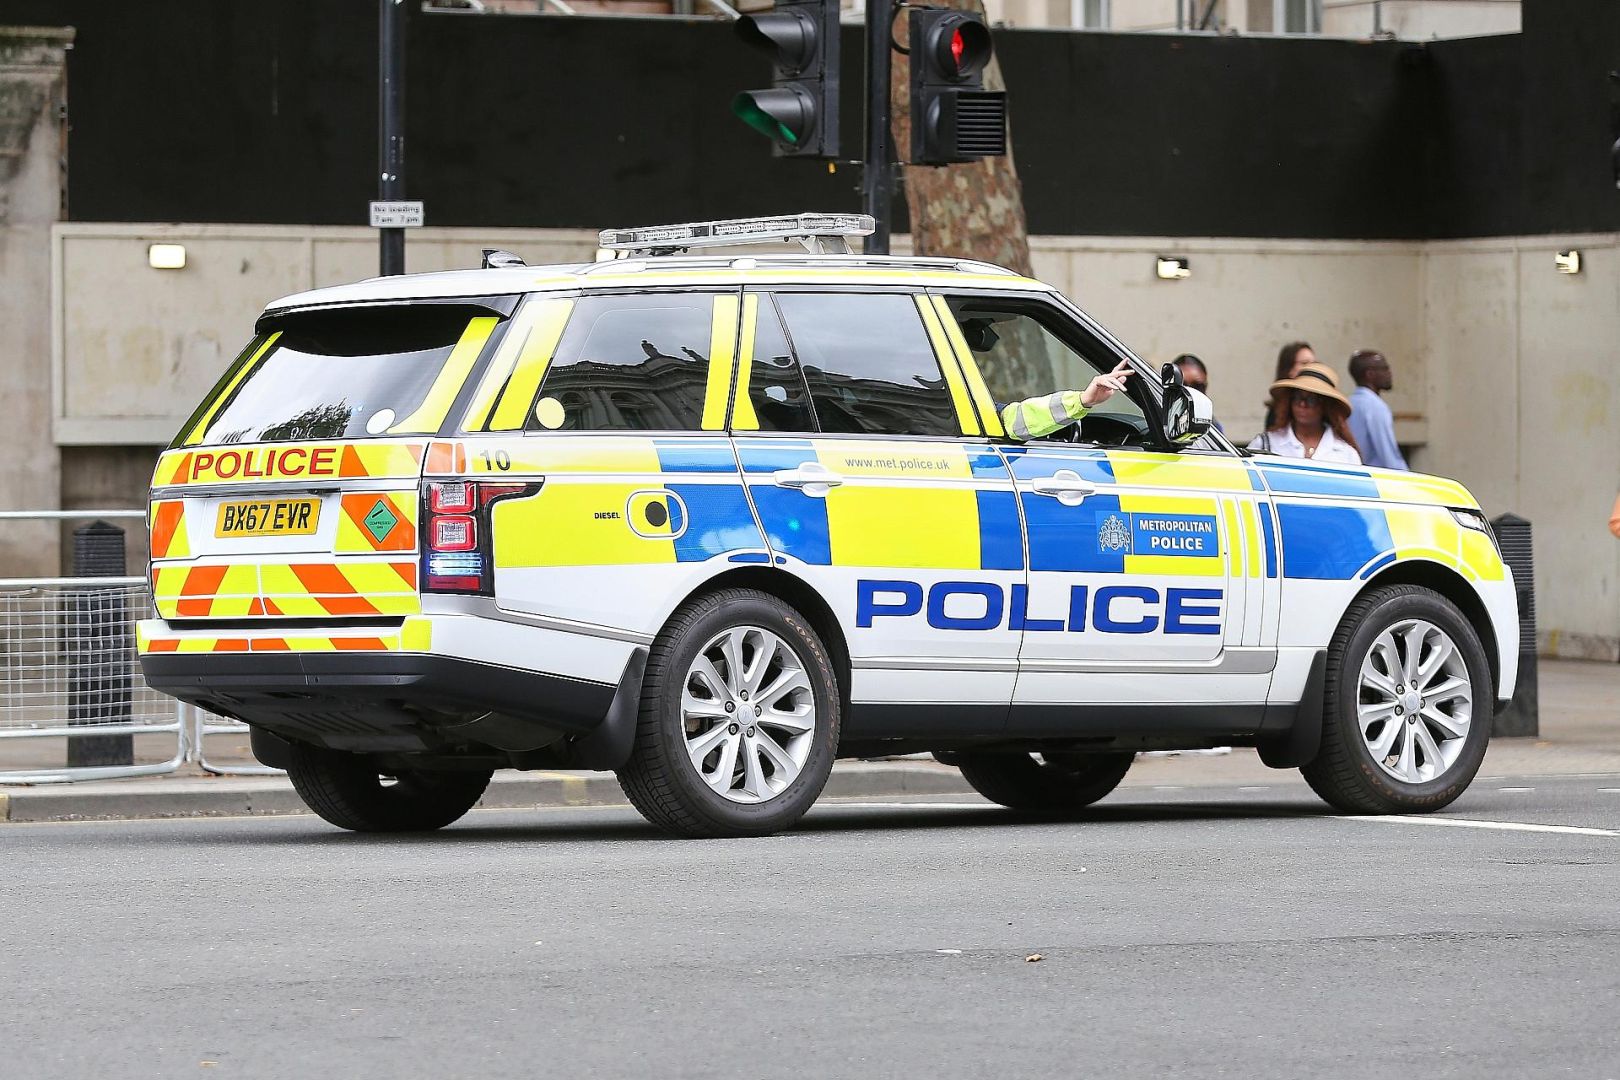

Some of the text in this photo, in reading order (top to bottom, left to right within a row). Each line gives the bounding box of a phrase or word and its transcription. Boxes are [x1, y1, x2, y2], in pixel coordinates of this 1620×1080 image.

[193, 448, 336, 479] POLICE
[480, 449, 511, 471] 10
[845, 458, 950, 471] www.met.police.uk
[223, 502, 311, 532] BX67 EVR
[1139, 519, 1213, 533] METROPOLITAN
[1151, 536, 1204, 550] POLICE
[855, 579, 1224, 635] POLICE
